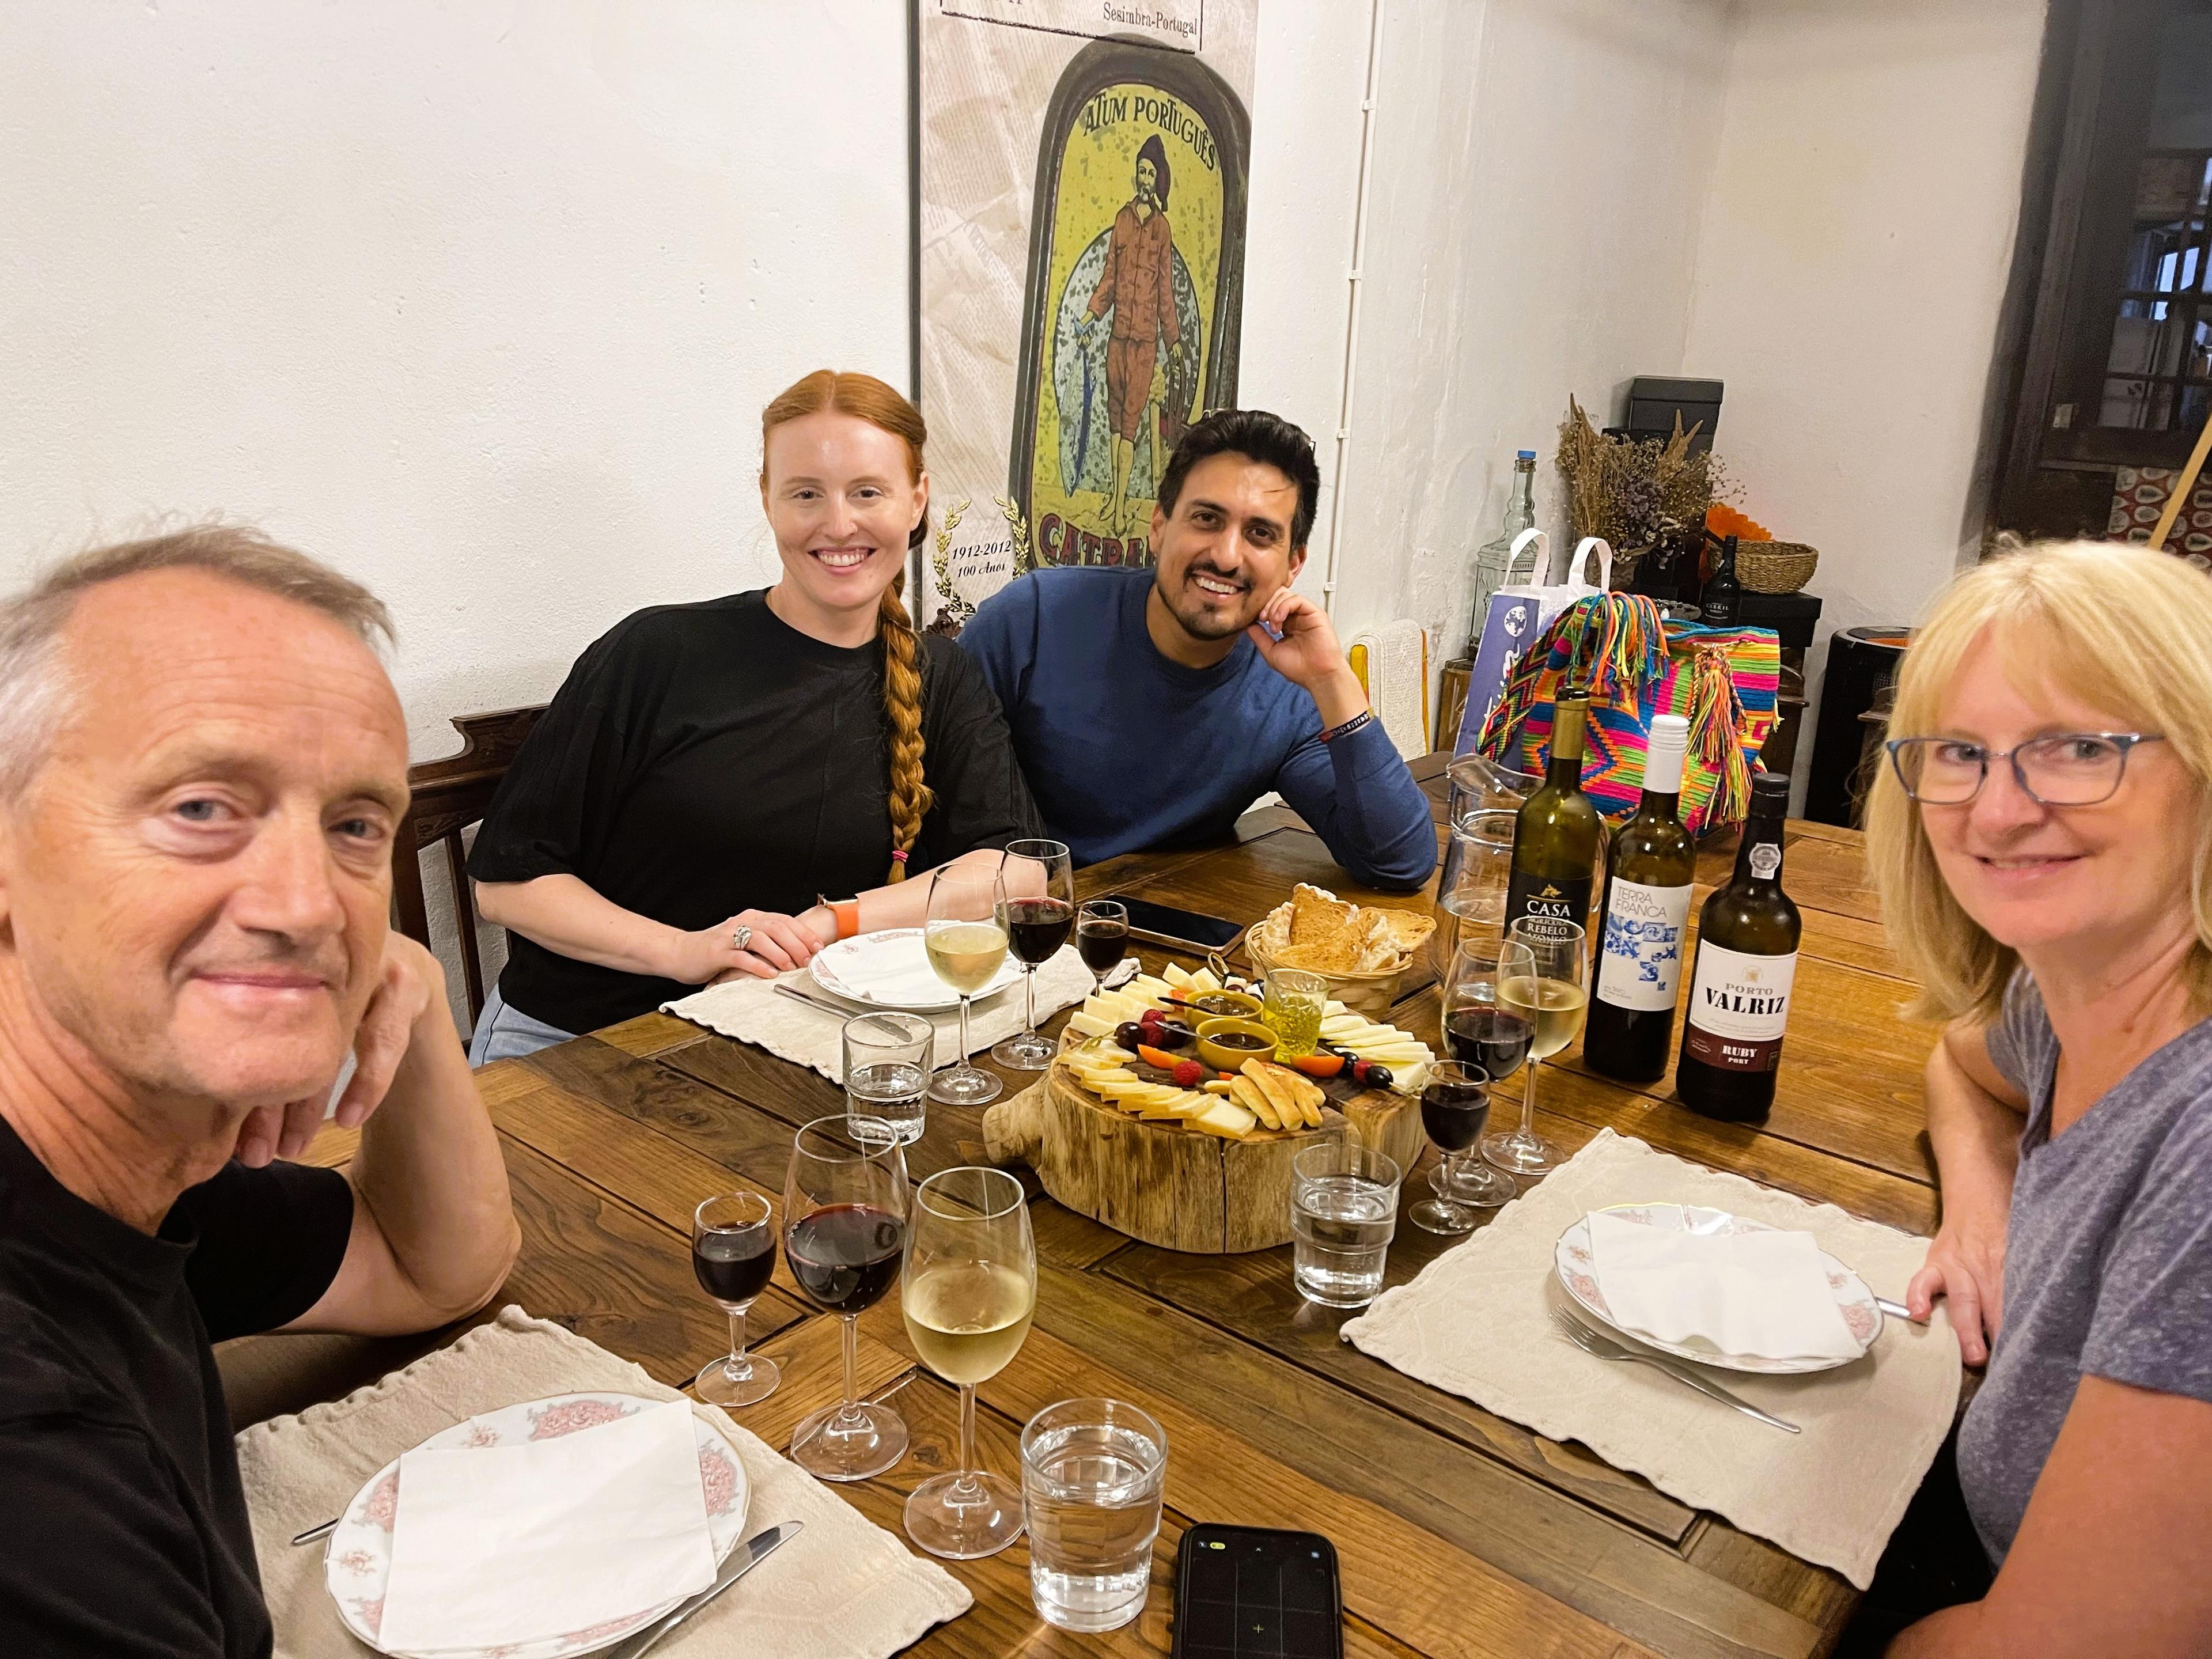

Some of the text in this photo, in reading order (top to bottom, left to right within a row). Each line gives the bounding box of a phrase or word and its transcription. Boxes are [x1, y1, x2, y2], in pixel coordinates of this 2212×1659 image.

[1103, 2, 1198, 38] Sesimbra-Portugal
[1084, 92, 1127, 136] ATUM
[953, 540, 1011, 560] 1912-2012
[958, 565, 976, 578] 100
[1618, 886, 1652, 904] TERRA
[1527, 900, 1571, 917] CASA
[1615, 899, 1666, 918] FRANCA
[1527, 923, 1567, 935] REBELO
[1726, 983, 1773, 995] PORTO
[1706, 987, 1785, 1014] VALRIZ
[1722, 1045, 1758, 1058] RUBY
